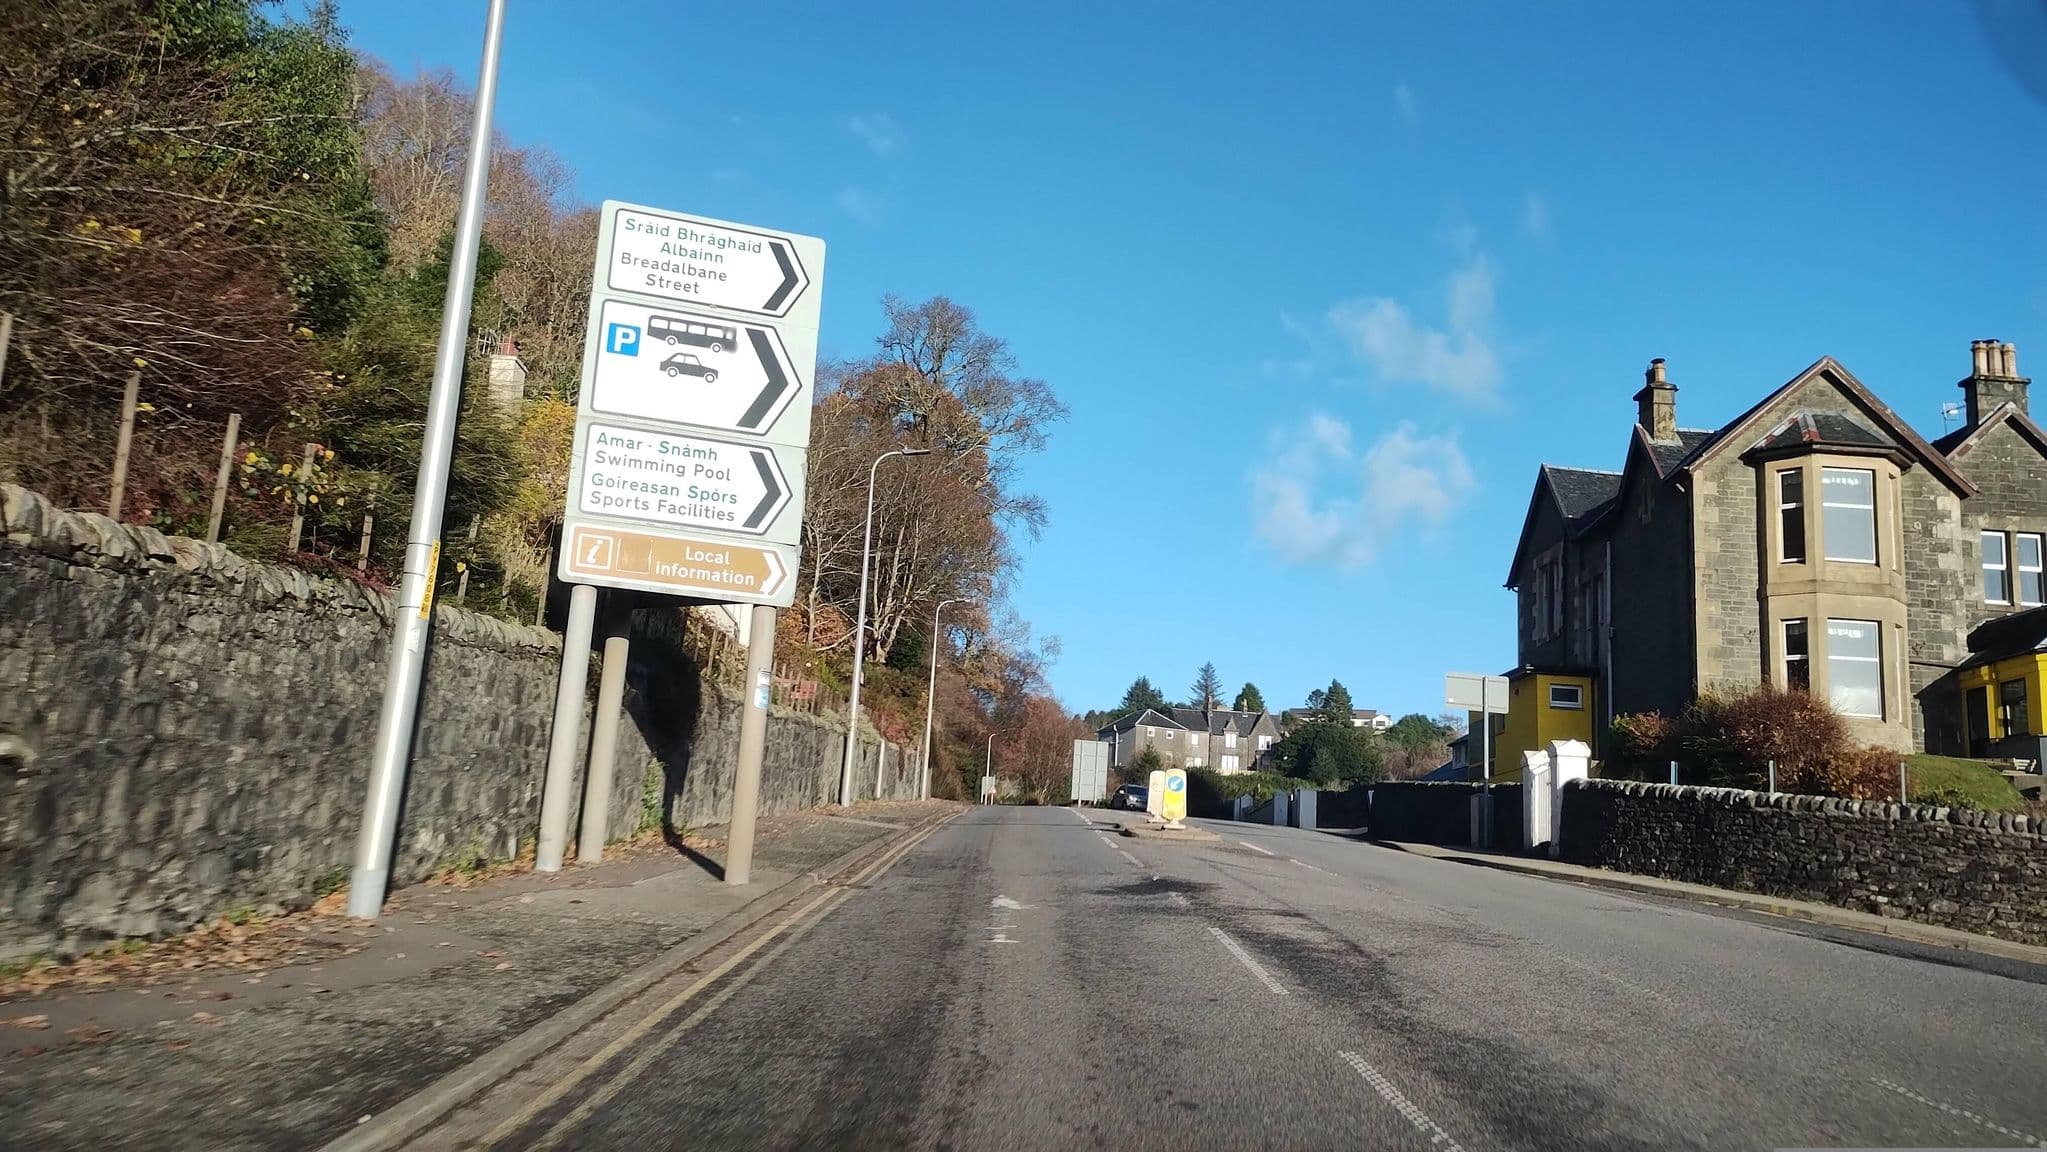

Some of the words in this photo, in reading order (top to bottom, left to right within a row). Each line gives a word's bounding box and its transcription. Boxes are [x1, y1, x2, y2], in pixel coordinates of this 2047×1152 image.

[660, 241, 724, 264] Albainn
[621, 252, 728, 282] Breadalbane
[645, 273, 700, 294] Street
[614, 327, 637, 352] P
[596, 432, 643, 450] Amar
[594, 450, 686, 477] Swimming
[694, 463, 731, 481] Pool
[591, 472, 680, 497] Goireasan
[590, 490, 650, 511] Sports
[657, 499, 735, 522] Facilities
[685, 545, 730, 565] Local
[656, 561, 754, 586] information
